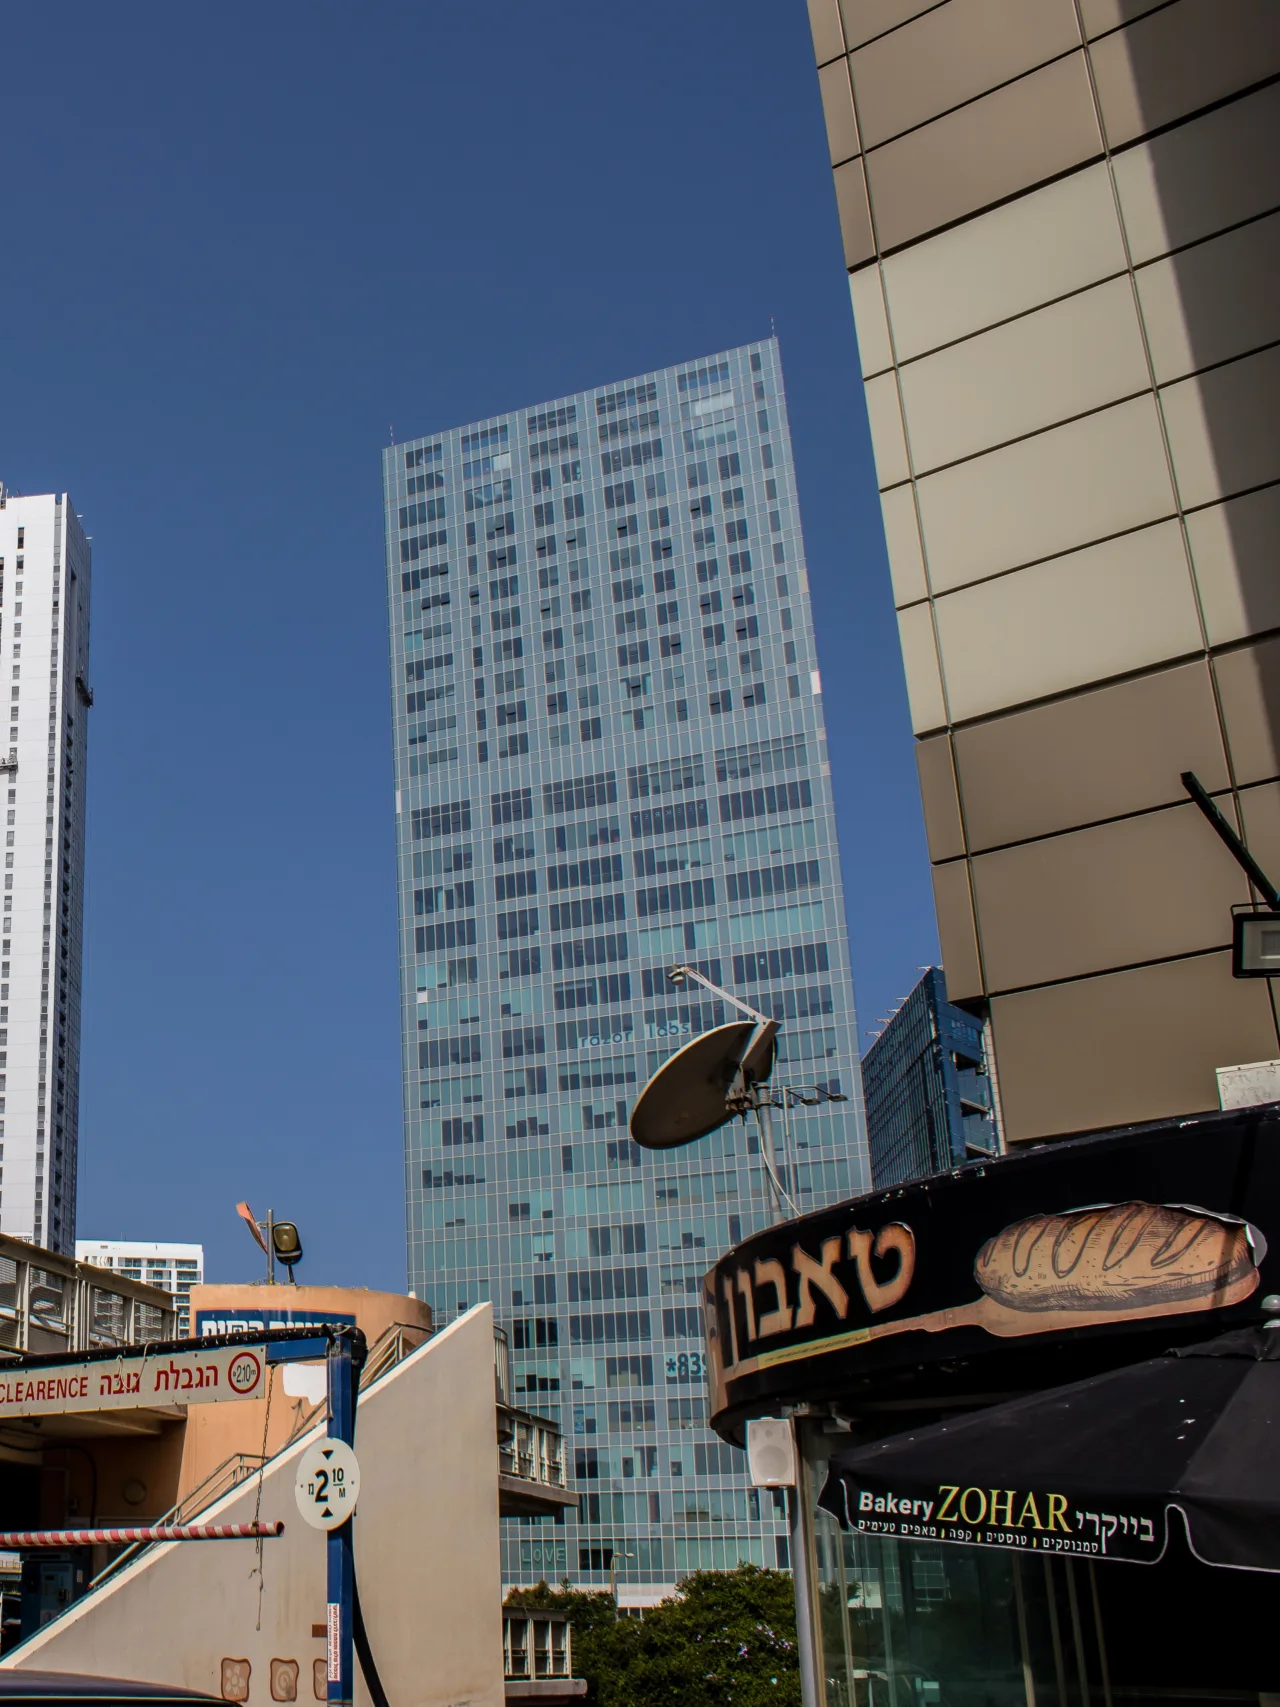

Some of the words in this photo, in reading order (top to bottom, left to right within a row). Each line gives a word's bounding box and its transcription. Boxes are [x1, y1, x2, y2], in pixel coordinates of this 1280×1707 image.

[581, 1031, 632, 1048] razor
[650, 1022, 689, 1039] labs
[723, 1222, 916, 1367] טאבון
[100, 1372, 141, 1396] גובה
[154, 1361, 218, 1392] הגבלת
[315, 1469, 329, 1503] 2
[332, 1467, 344, 1483] 10
[858, 1491, 934, 1521] Bakery
[936, 1485, 1073, 1533] ZOHAR
[858, 1520, 895, 1533] טעימים
[900, 1524, 937, 1538] מאפים
[949, 1529, 972, 1542] קפה
[1075, 1510, 1154, 1554] בייקרי
[986, 1532, 1027, 1547] טוסטים
[1042, 1537, 1098, 1553] סמבוסקים
[522, 1547, 566, 1564] LOVE
